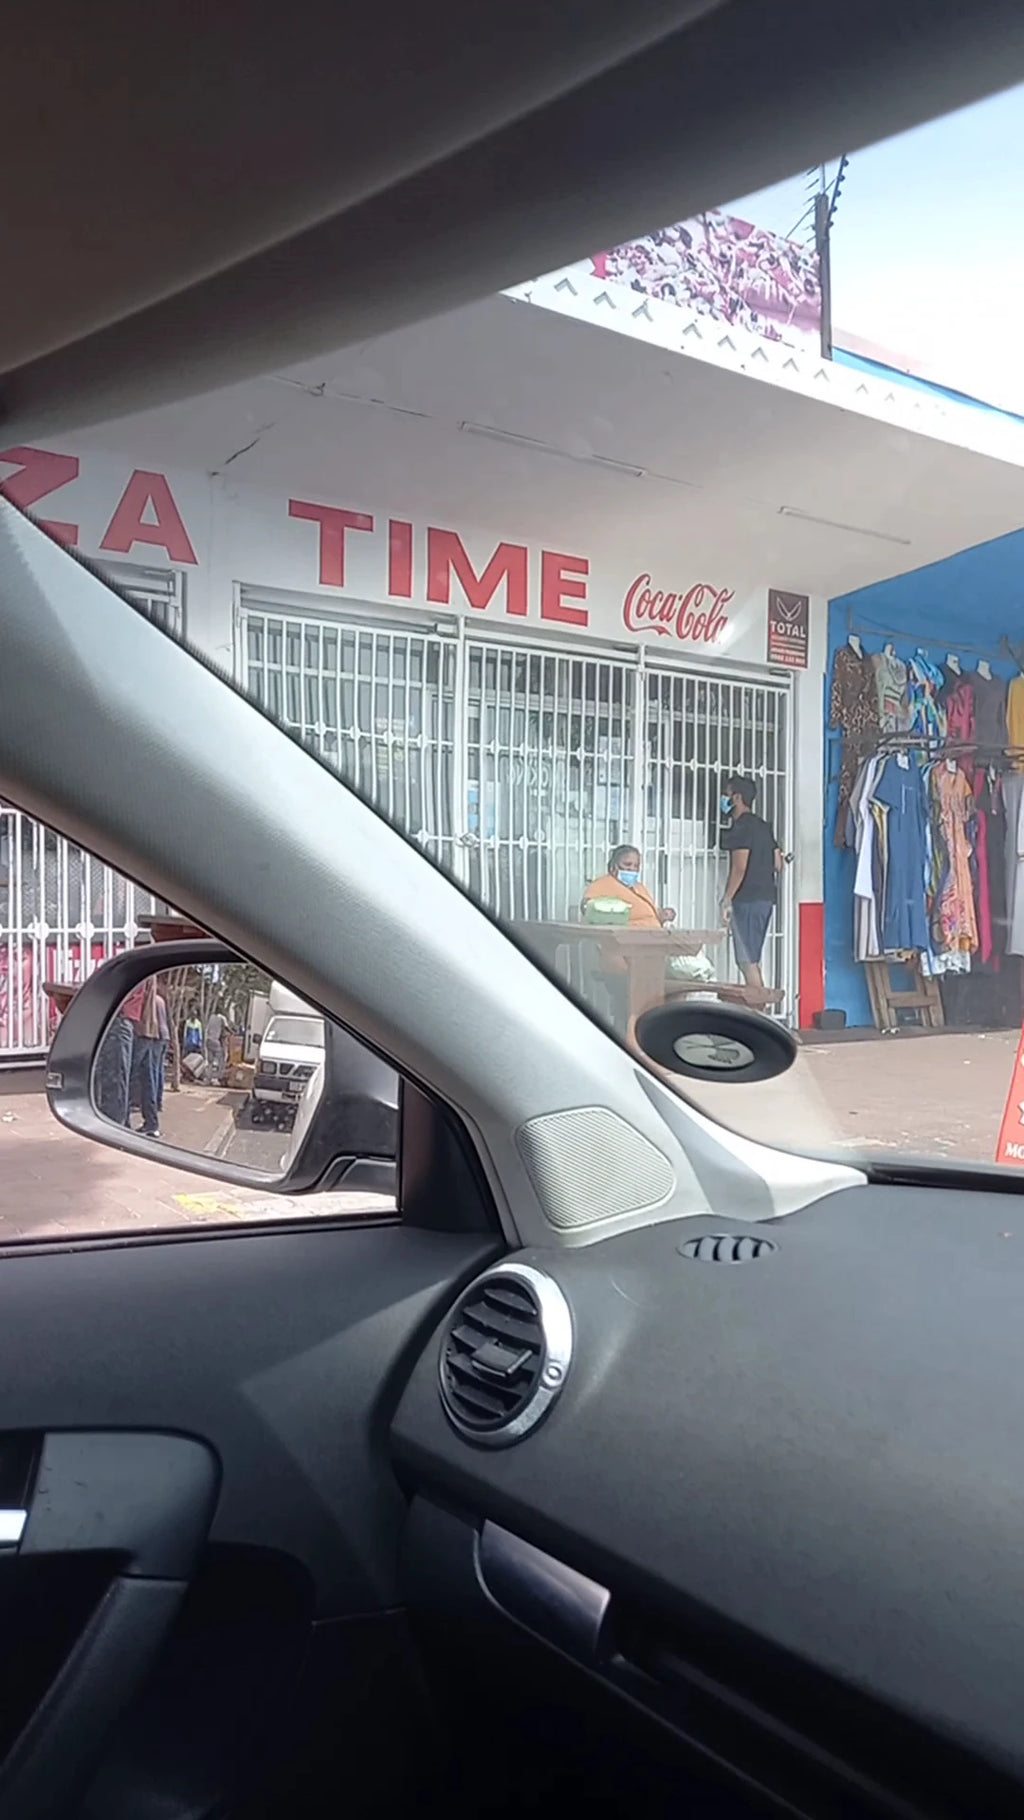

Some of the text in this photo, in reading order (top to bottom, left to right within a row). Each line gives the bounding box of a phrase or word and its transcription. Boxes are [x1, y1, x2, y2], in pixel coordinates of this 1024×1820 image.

[288, 498, 590, 627] TIME
[623, 573, 735, 643] Coca-Cola
[769, 619, 807, 639] TOTAL
